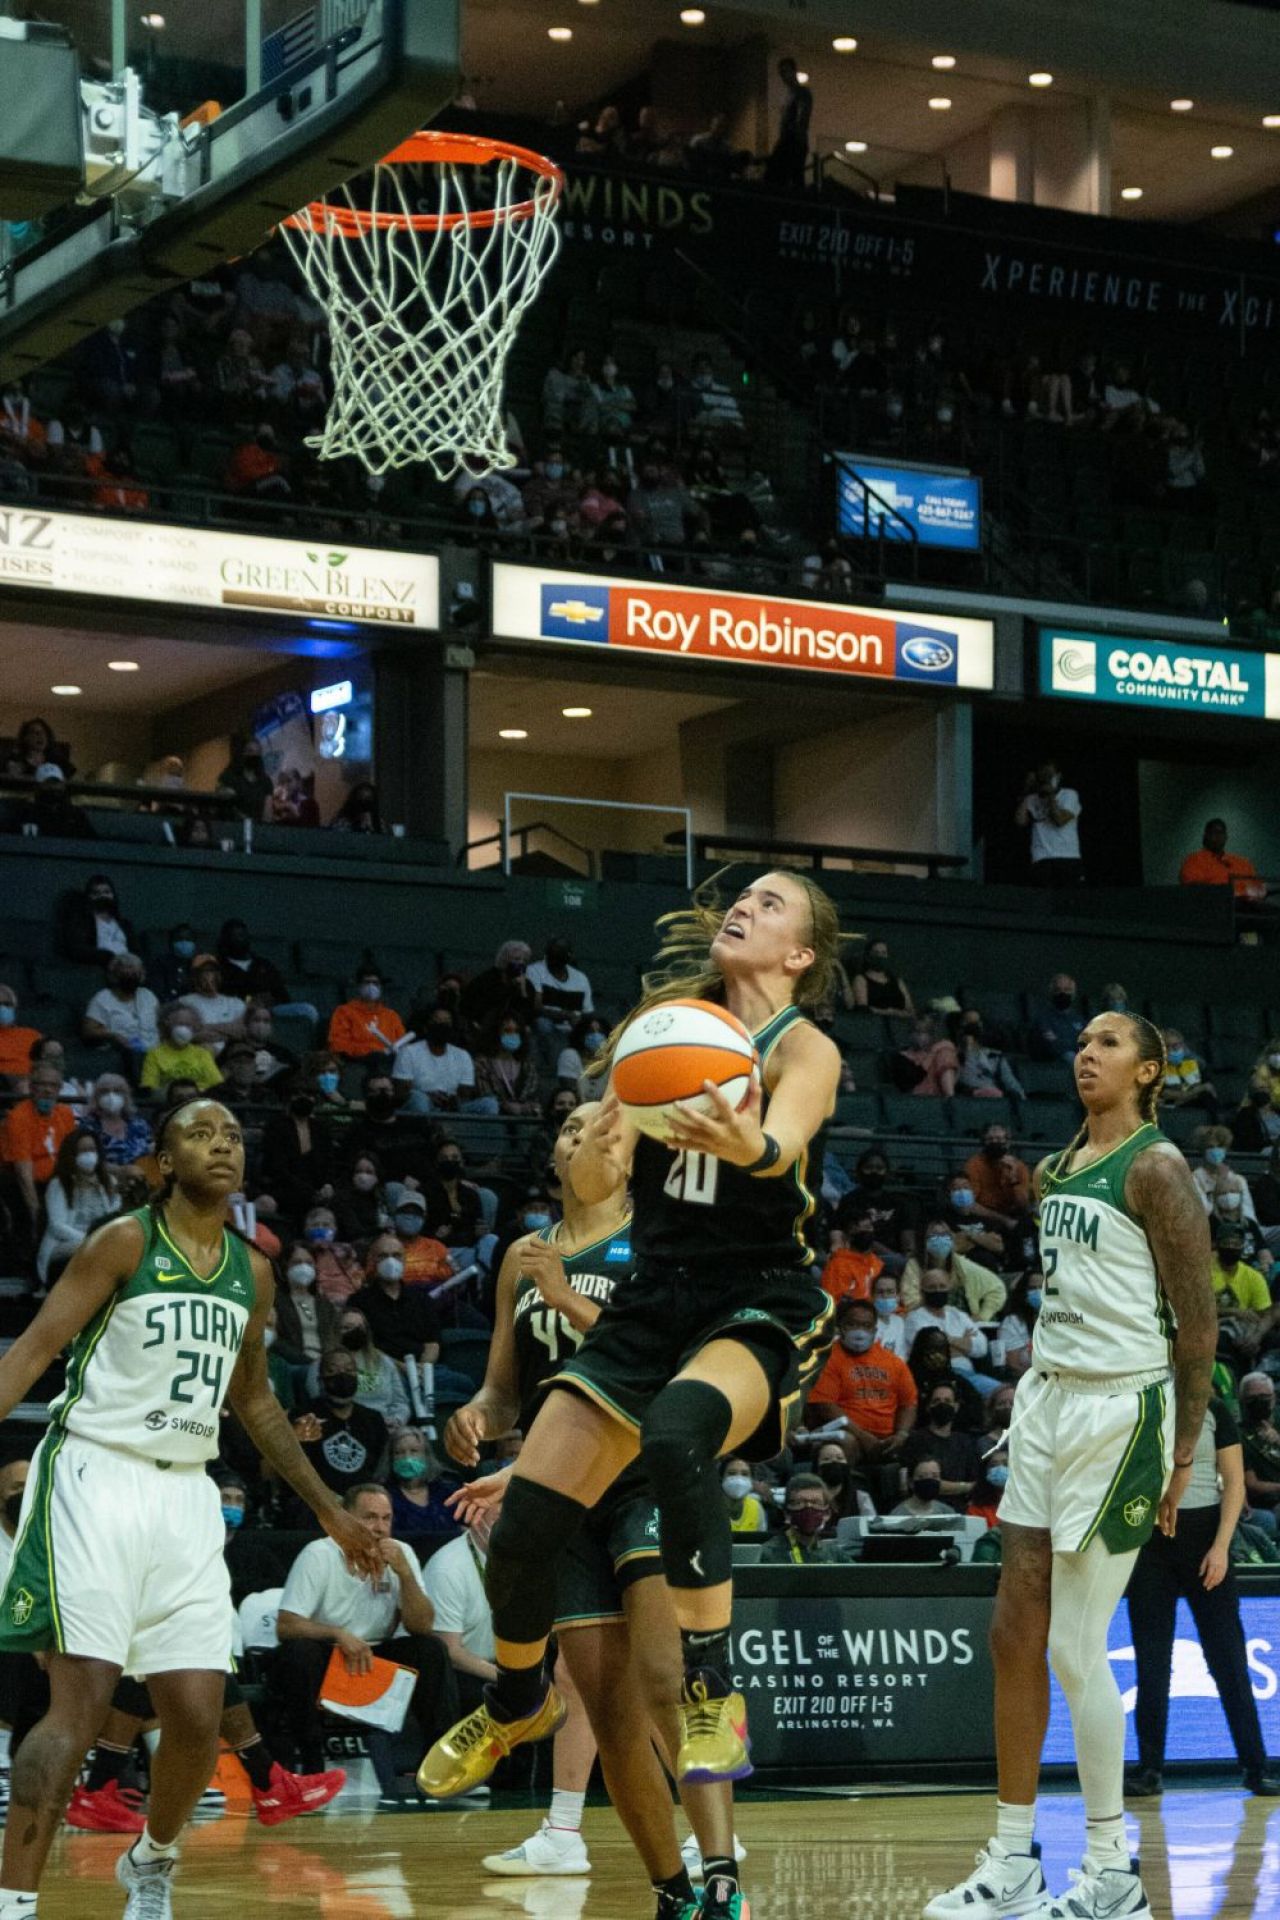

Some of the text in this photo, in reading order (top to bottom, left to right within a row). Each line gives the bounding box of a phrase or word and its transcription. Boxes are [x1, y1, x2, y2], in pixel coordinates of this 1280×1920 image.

[563, 175, 714, 234] WINDS
[563, 221, 653, 250] ESORT
[778, 221, 814, 246] EXIT
[980, 252, 1163, 313] XPERIENCE
[324, 602, 412, 622] COMPOST
[626, 598, 883, 665] Roy Robinson
[1108, 649, 1249, 692] COASTAL
[1116, 680, 1199, 702] COMMUNITY
[142, 1299, 244, 1353] STORM
[170, 1349, 224, 1408] 24
[170, 1417, 216, 1439] SWEDIS
[816, 1648, 840, 1659] THE
[817, 1634, 835, 1646] OF
[842, 1627, 975, 1666] WINDS
[732, 1673, 929, 1688] CASINO RESORT
[773, 1695, 806, 1715] EXIT
[810, 1695, 836, 1714] 210
[840, 1695, 868, 1714] OFF
[872, 1718, 894, 1728] WA
